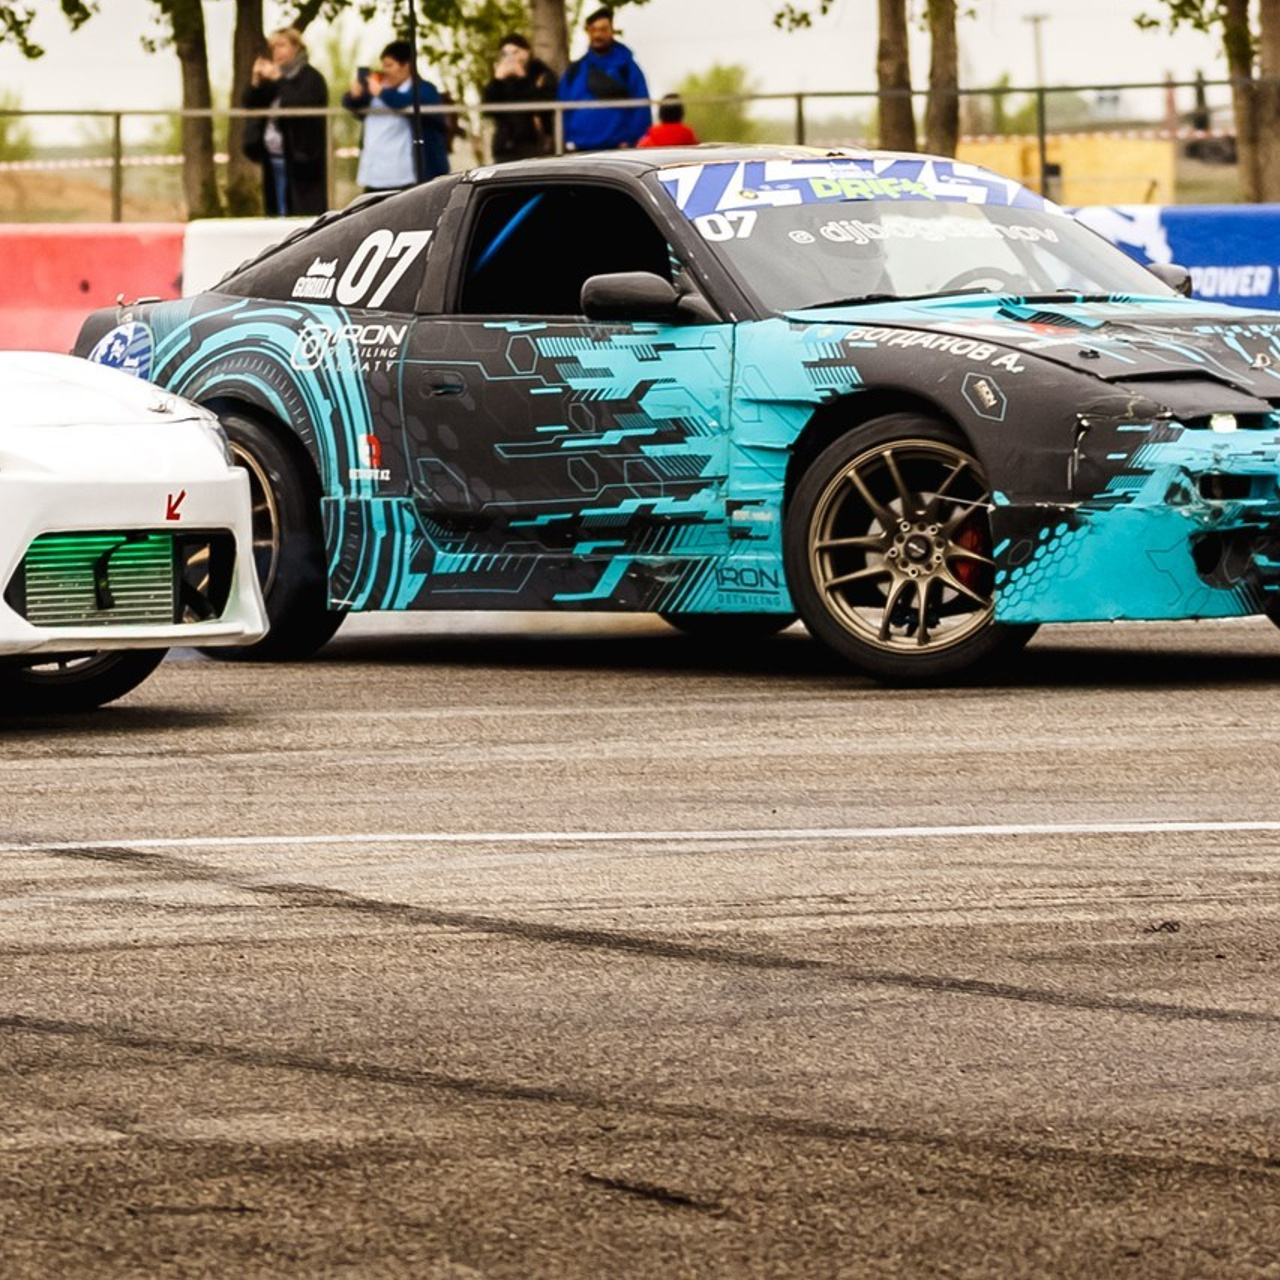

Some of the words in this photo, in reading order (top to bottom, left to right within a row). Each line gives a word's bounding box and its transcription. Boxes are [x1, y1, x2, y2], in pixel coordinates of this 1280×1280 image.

[808, 177, 937, 201] DRIFT
[694, 210, 758, 242] 07
[336, 228, 433, 308] 07
[1189, 266, 1273, 297] POWER
[326, 347, 399, 358] DAILING
[845, 327, 998, 361] БОГДАНОВ
[715, 566, 779, 589] IRON
[718, 593, 780, 607] DETAILING
